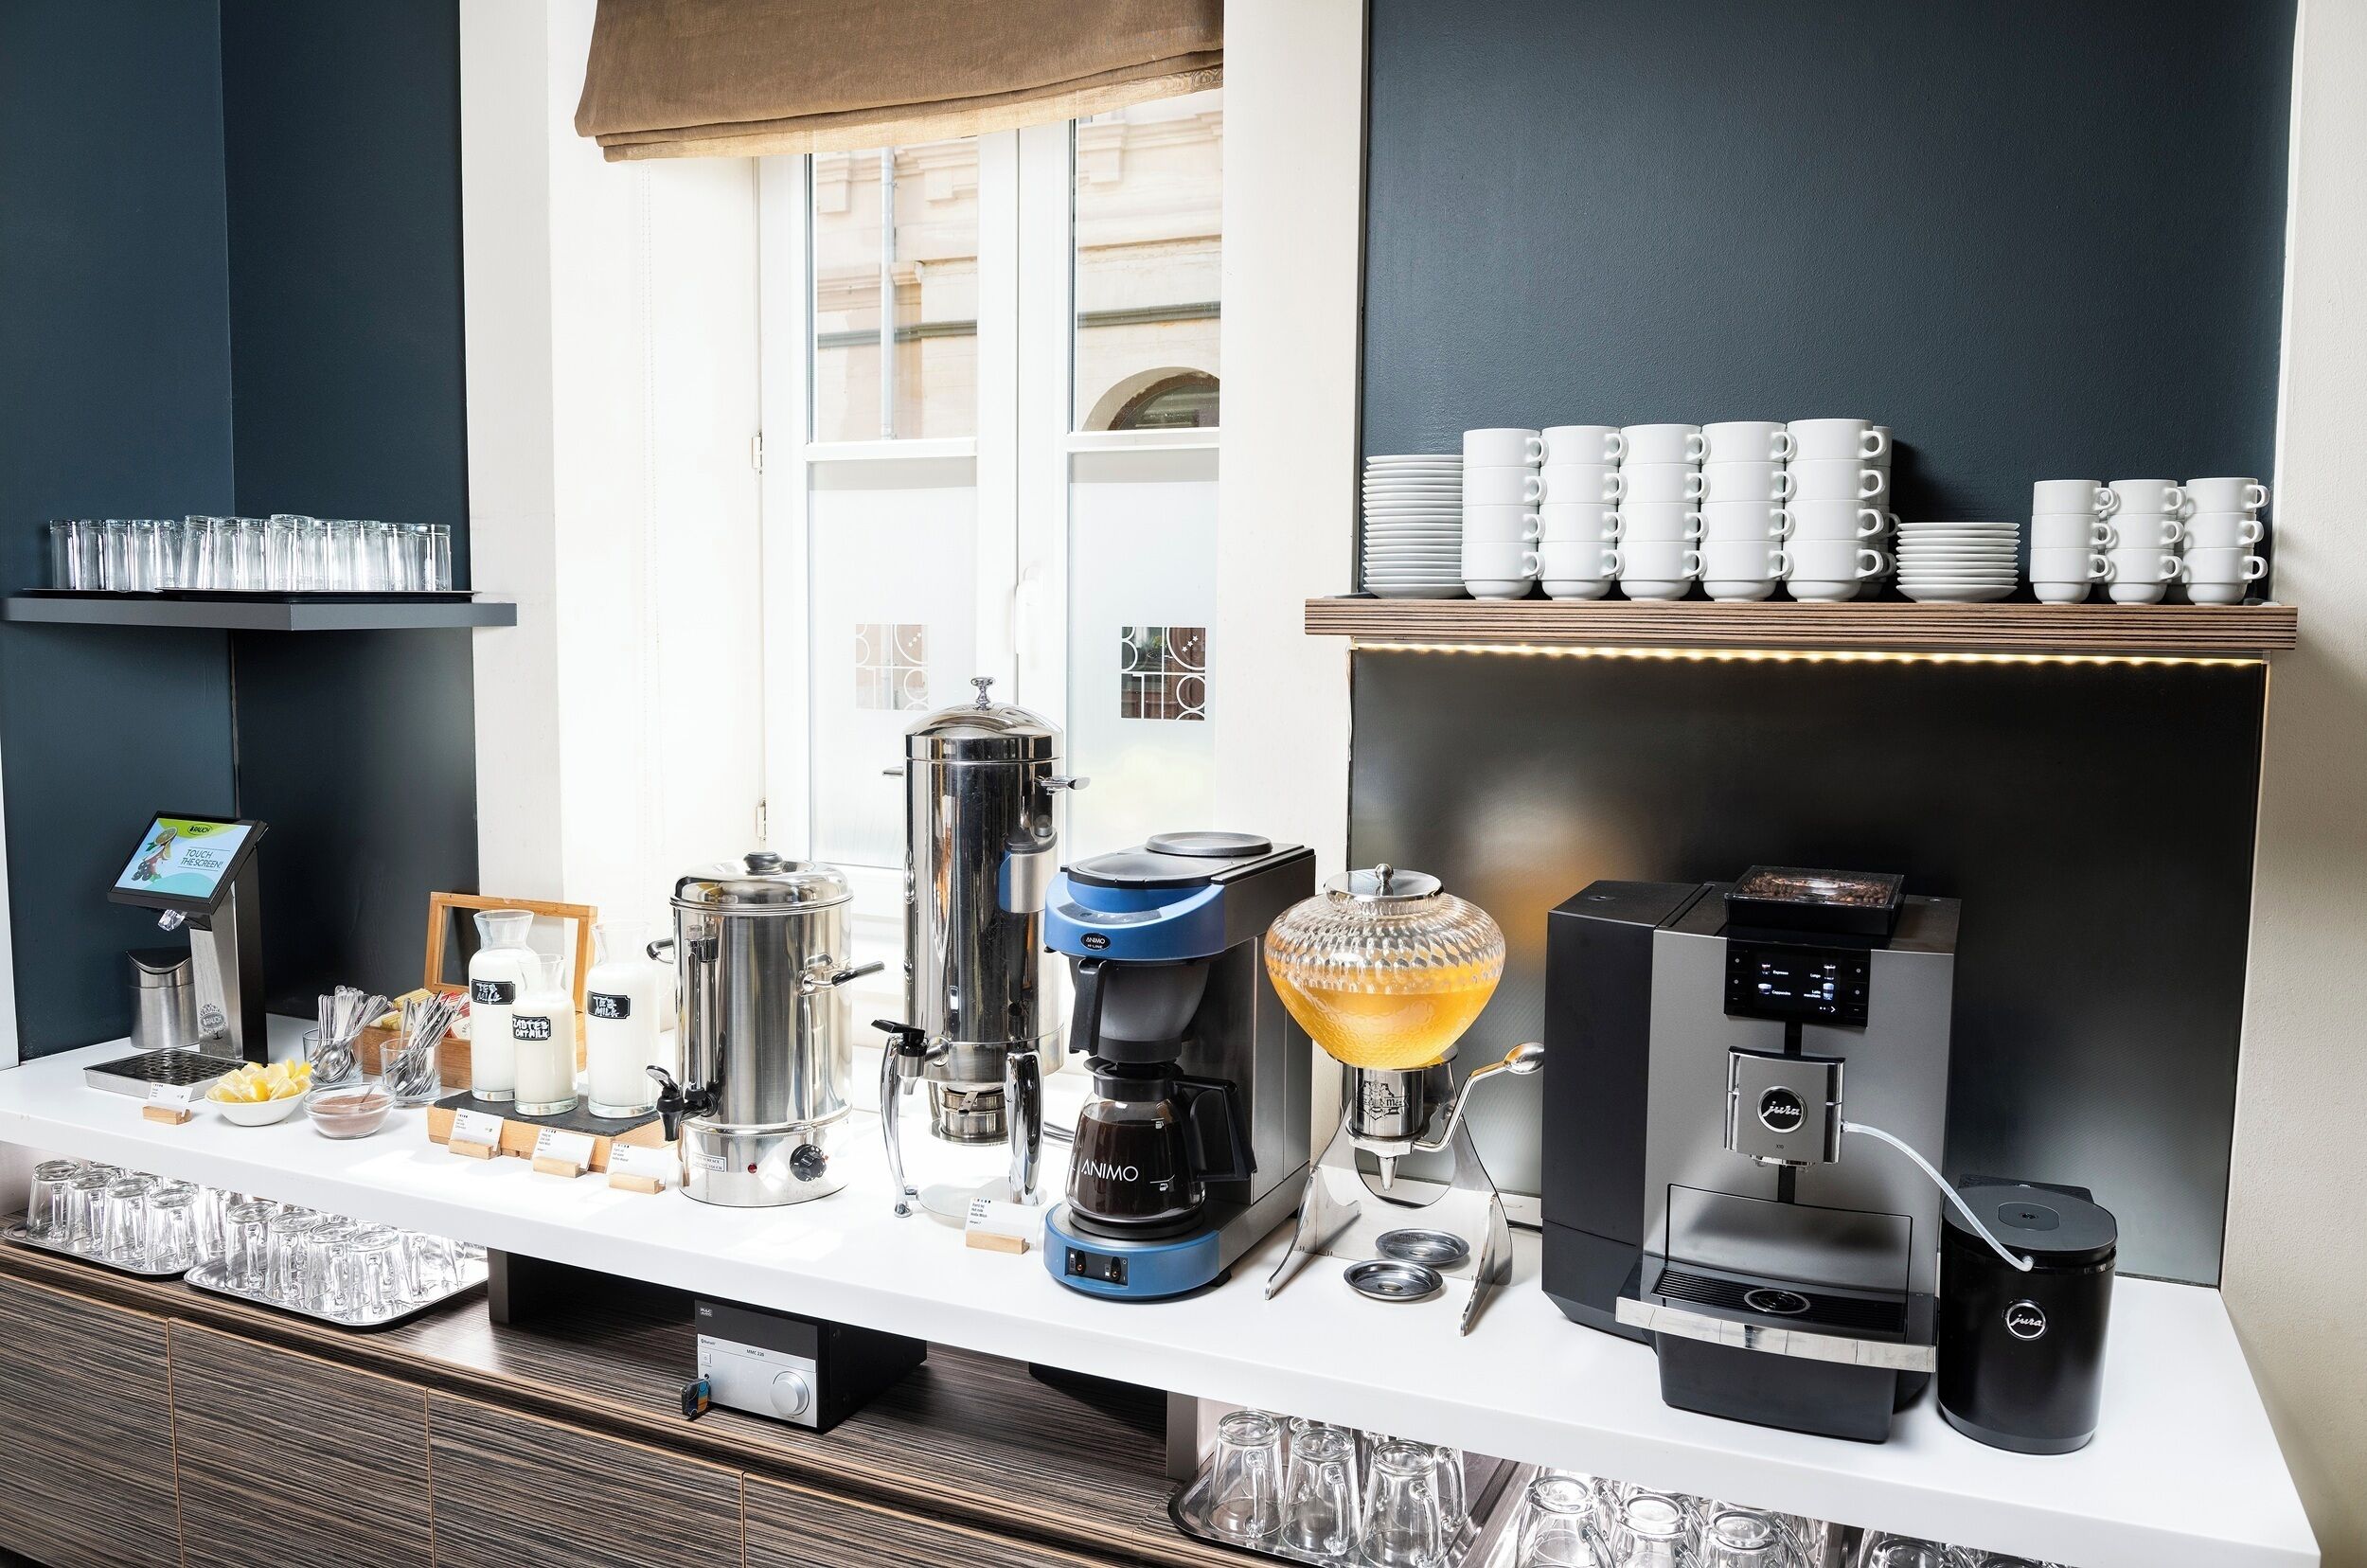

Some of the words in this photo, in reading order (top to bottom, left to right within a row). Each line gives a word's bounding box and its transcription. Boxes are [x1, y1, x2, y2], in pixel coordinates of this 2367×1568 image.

[186, 849, 213, 859] TOUCH
[1761, 1100, 1801, 1117] jura
[1080, 1158, 1139, 1182] ANIMO
[2009, 1313, 2043, 1327] jura
